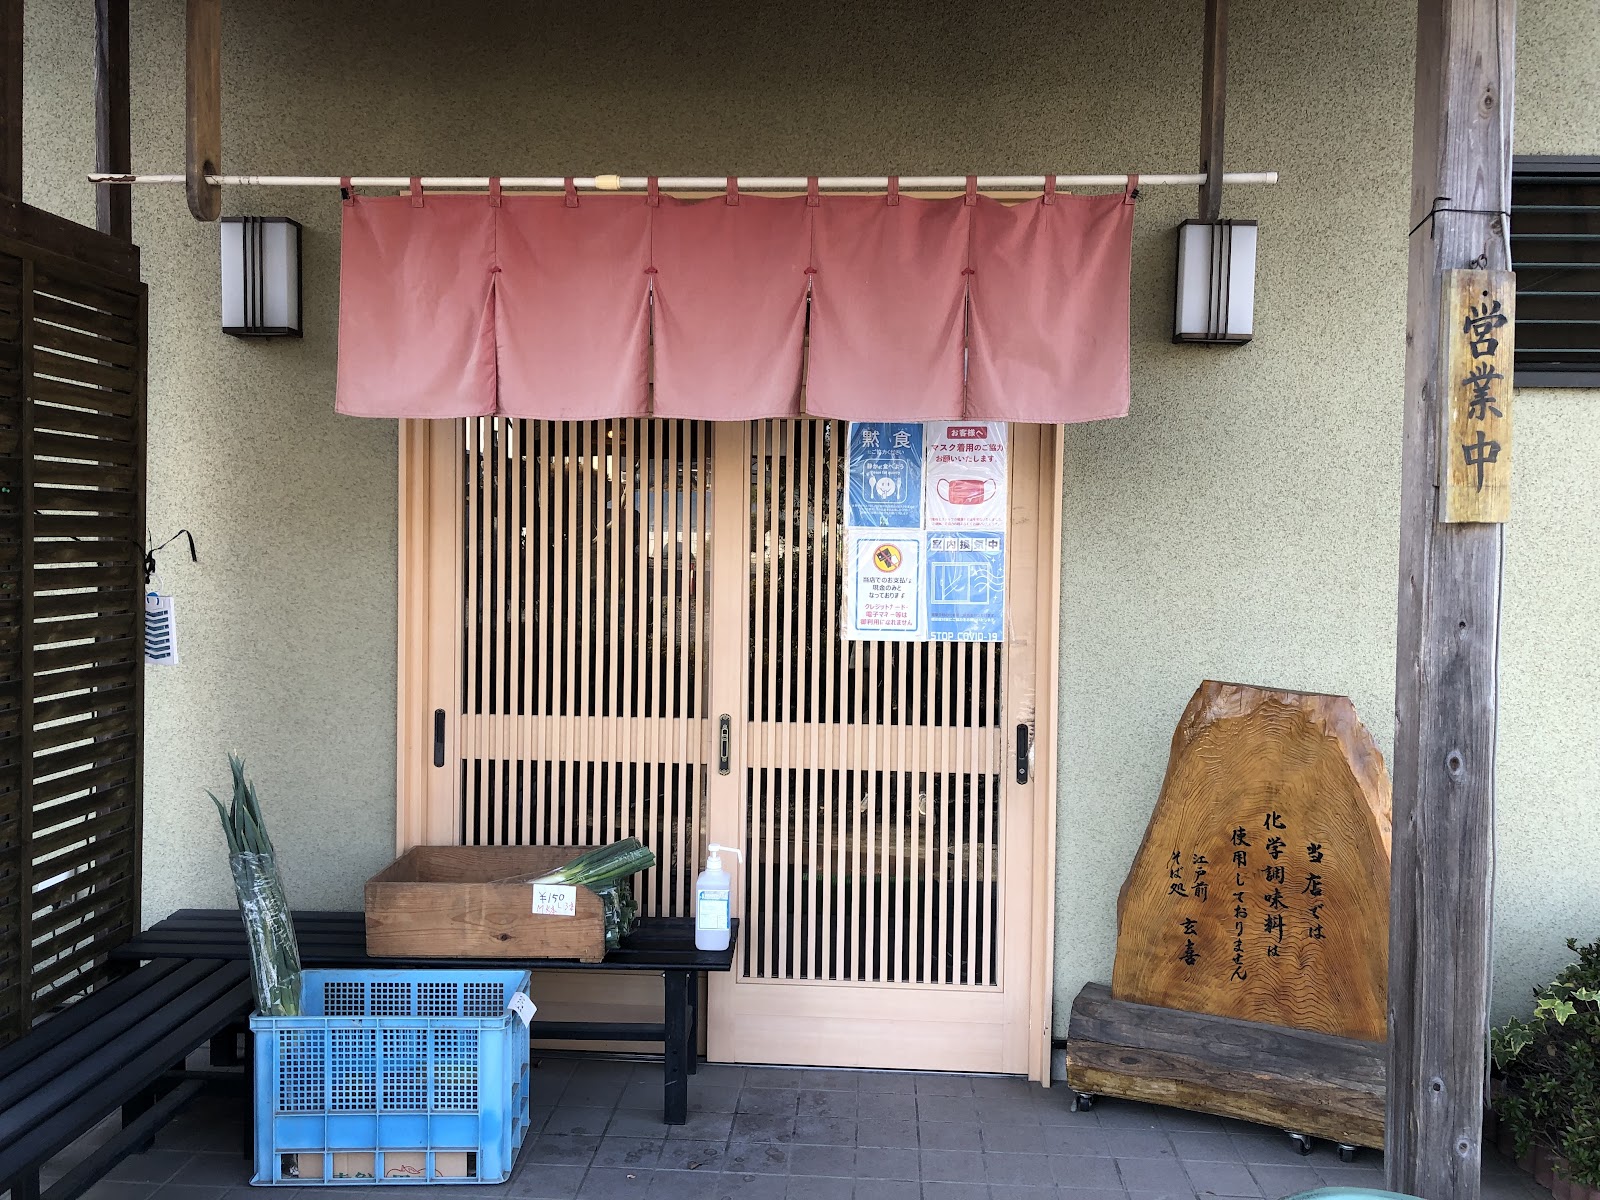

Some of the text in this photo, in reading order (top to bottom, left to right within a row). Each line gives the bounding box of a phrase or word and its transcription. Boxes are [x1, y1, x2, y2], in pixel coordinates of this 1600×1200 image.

[1462, 300, 1508, 494] 営業中
[931, 443, 1004, 452] マスク着用のご協力
[951, 428, 984, 437] お客様へ
[930, 631, 998, 641] STOP COVID-19
[538, 891, 565, 904] ¥150
[1166, 850, 1189, 898] そば処
[1192, 852, 1209, 902] 江戸前
[1261, 810, 1289, 957] 化学調味料は
[1301, 842, 1327, 940] 当店では
[1230, 825, 1252, 981] 使用しておりません
[1178, 917, 1201, 966] 玄喜
